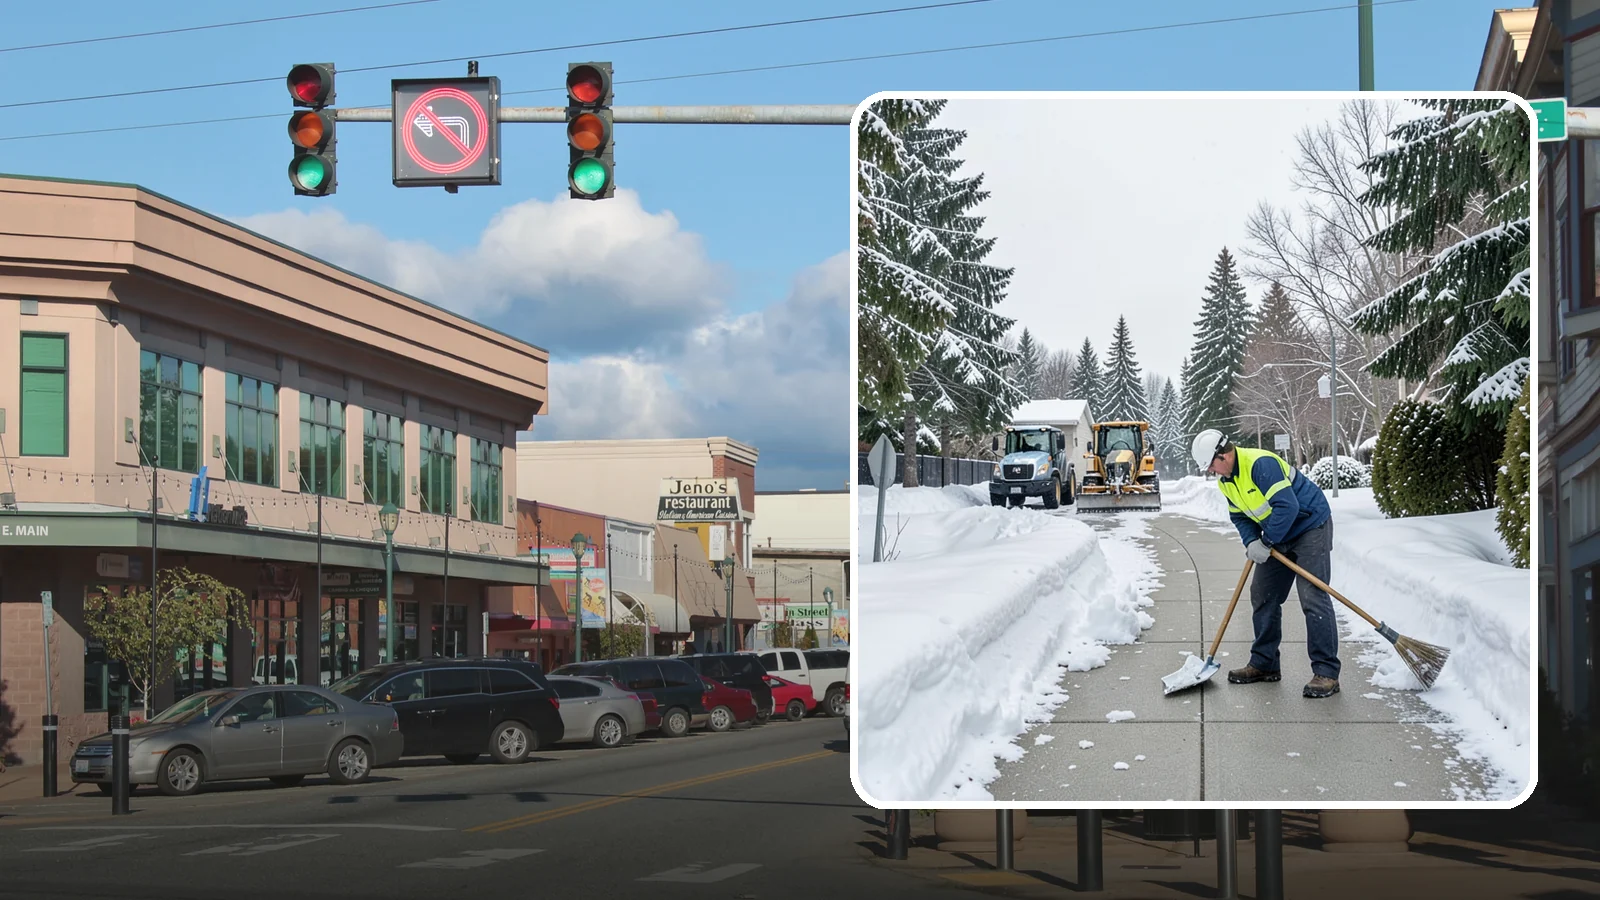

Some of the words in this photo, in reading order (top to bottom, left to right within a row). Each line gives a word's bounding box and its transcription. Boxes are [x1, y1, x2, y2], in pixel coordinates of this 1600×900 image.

[670, 480, 727, 494] Jeno's
[665, 496, 731, 509] restaurant
[658, 510, 682, 519] Italian
[686, 510, 715, 519] American
[715, 509, 737, 519] Cuisine
[2, 525, 13, 536] E.
[15, 525, 49, 536] MAIN
[797, 607, 828, 617] Street
[791, 619, 823, 627] lass
